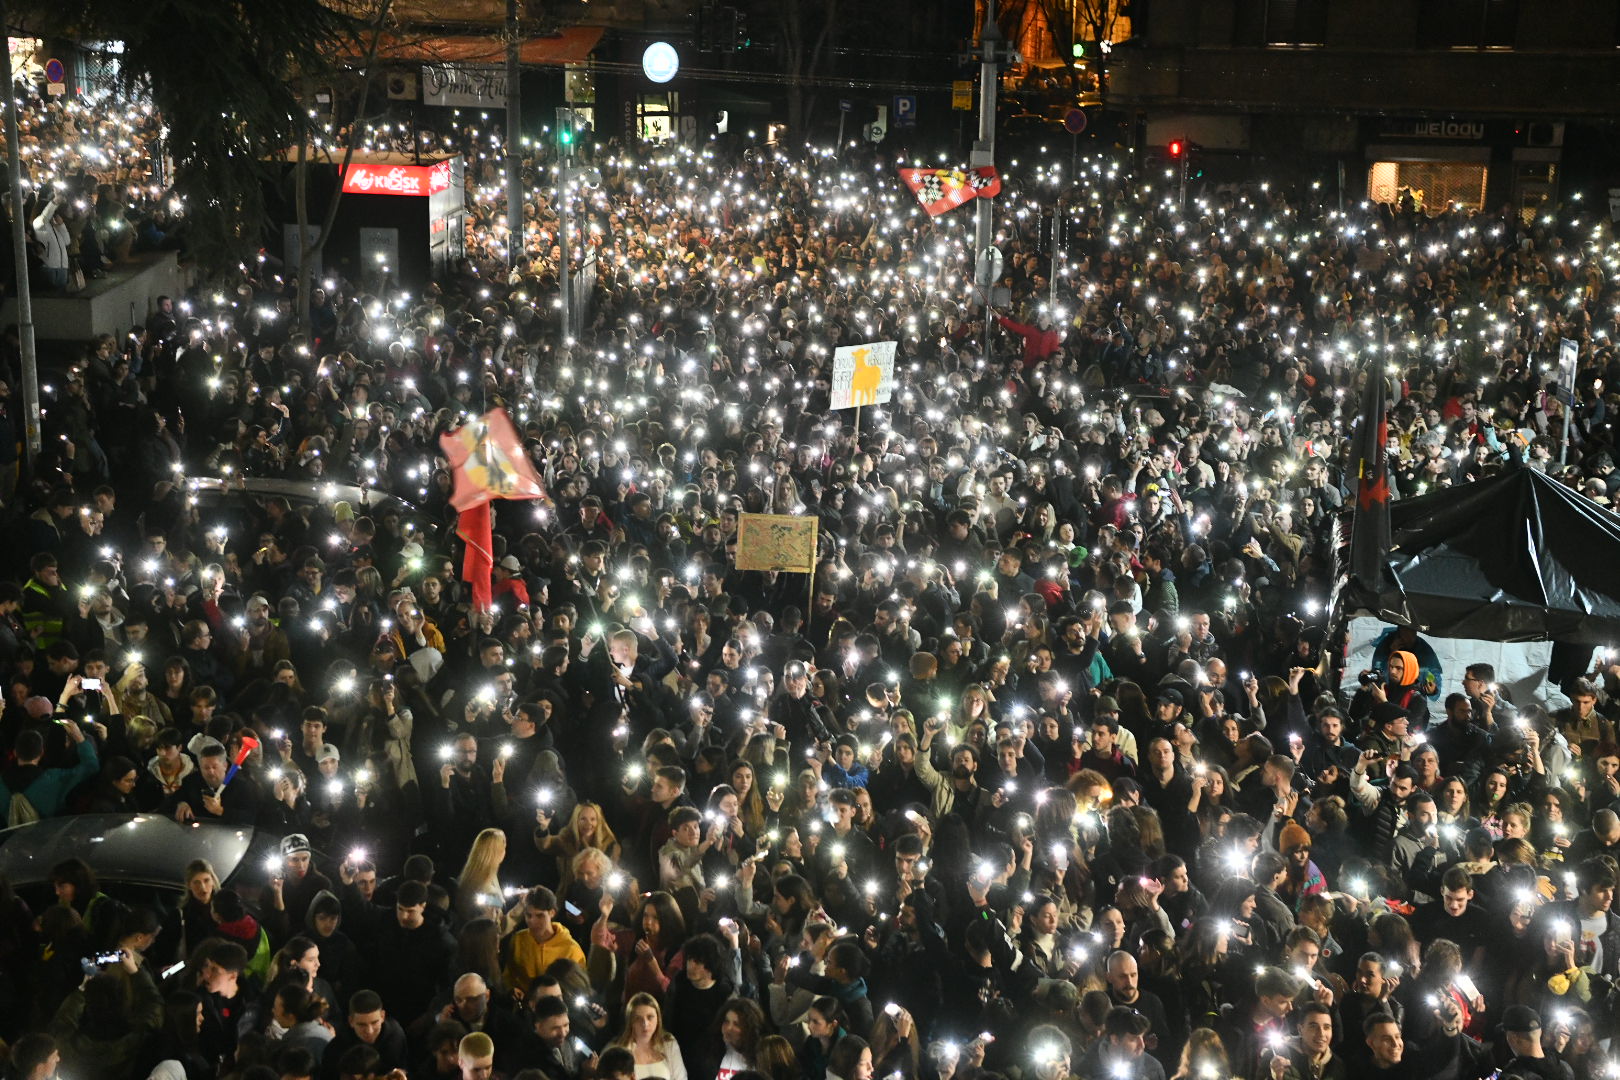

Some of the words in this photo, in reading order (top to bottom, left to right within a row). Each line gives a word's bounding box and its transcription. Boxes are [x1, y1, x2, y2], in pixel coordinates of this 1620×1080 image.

[898, 98, 911, 115] P
[349, 169, 374, 190] Moj
[374, 173, 420, 190] KIOSK
